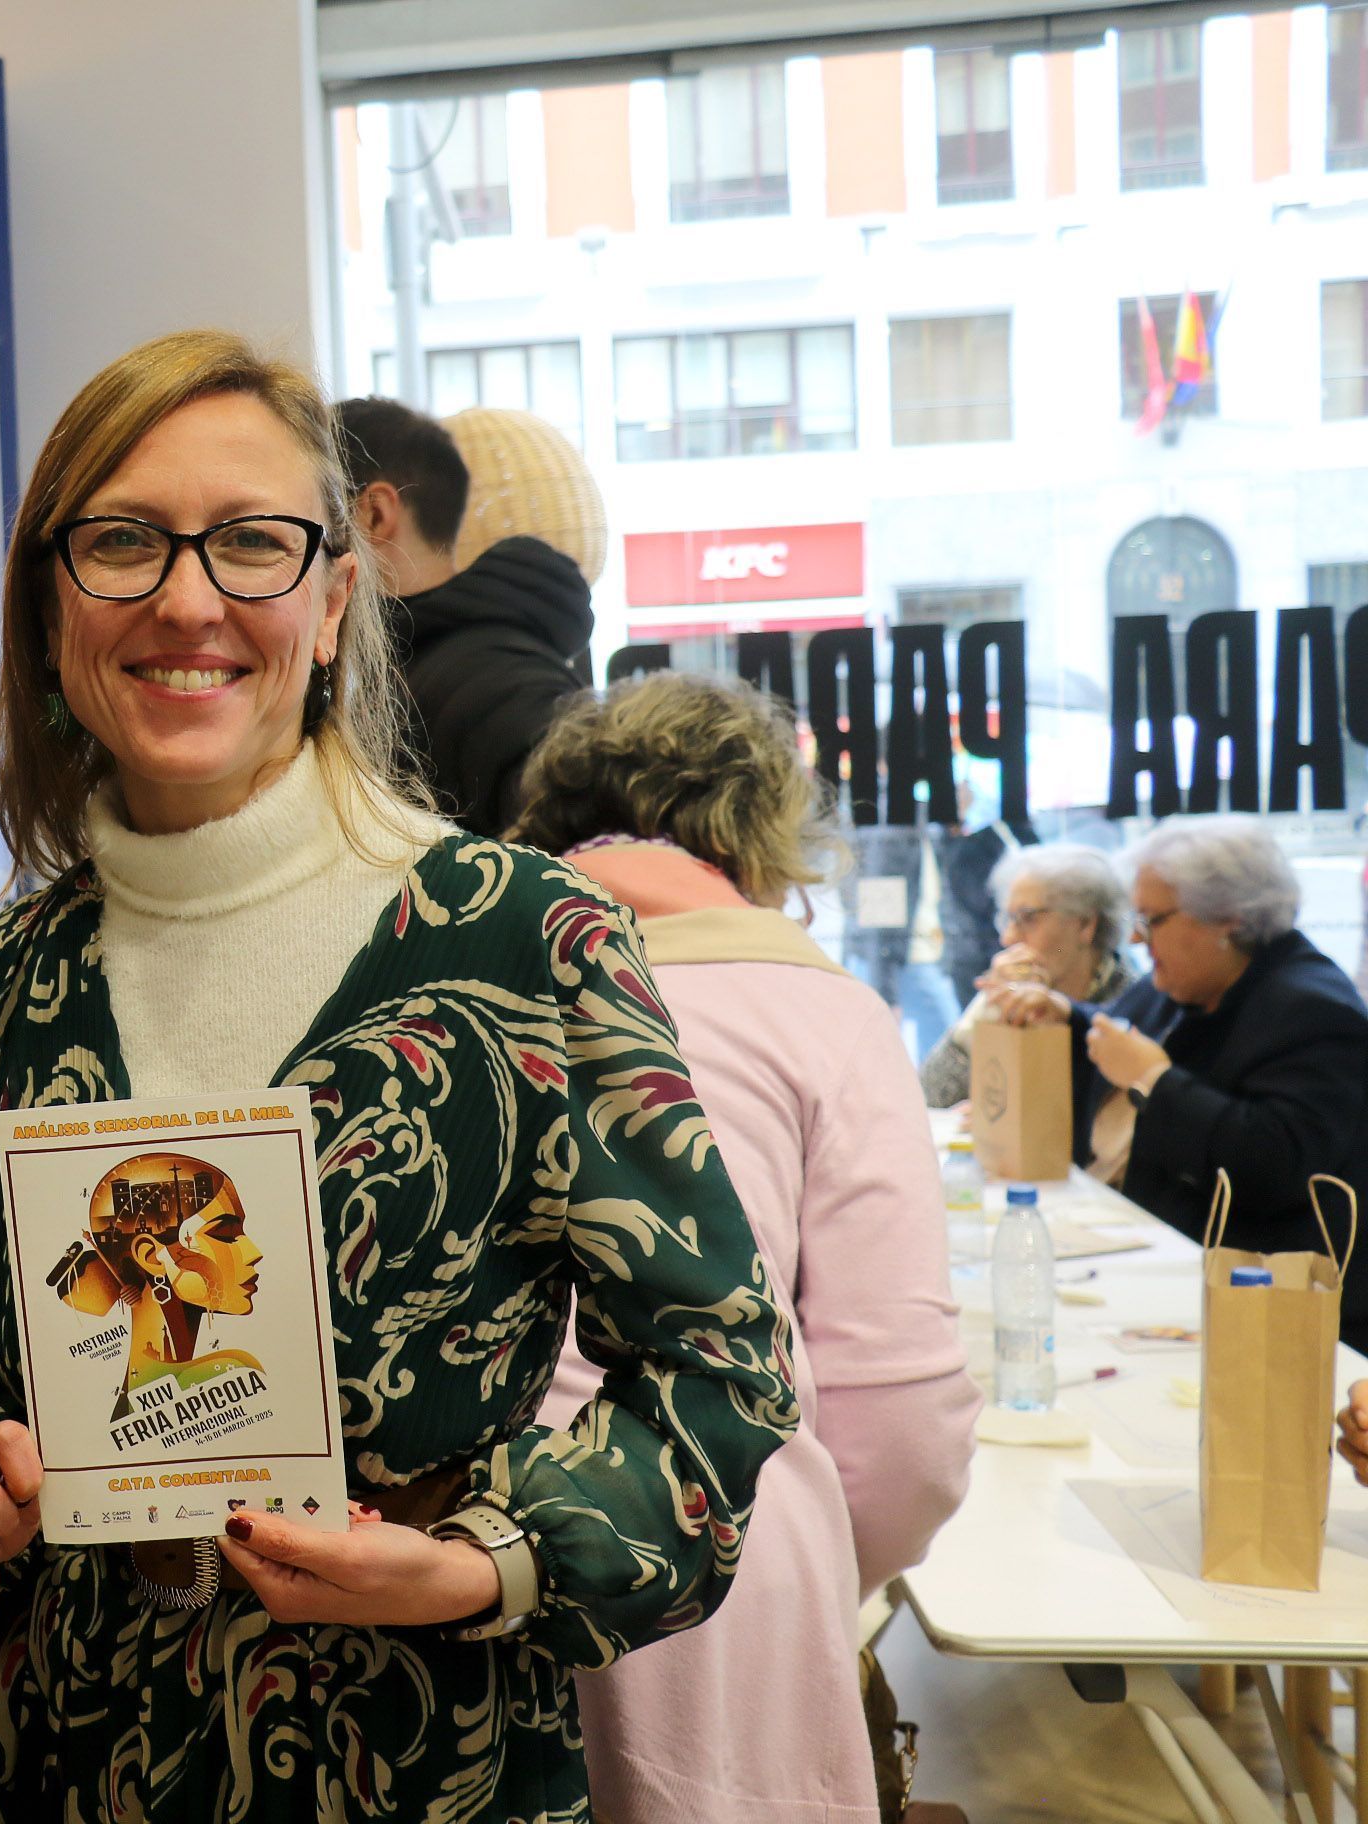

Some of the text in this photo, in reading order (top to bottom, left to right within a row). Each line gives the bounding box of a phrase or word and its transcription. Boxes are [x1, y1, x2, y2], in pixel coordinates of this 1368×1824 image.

[699, 542, 788, 580] KFC
[13, 1105, 294, 1140] ANÁLISIS SENSORIAL DE LA MIEL
[68, 1324, 129, 1358] PASTRANA
[109, 1370, 267, 1452] FERIA APÍCOLA
[135, 1382, 175, 1412] XLIV
[160, 1405, 248, 1449] INTERNACIONAL
[214, 1430, 223, 1441] DE
[223, 1420, 246, 1437] MARZO
[246, 1416, 255, 1427] DE
[255, 1409, 274, 1424] 2025
[107, 1468, 272, 1492] CATA COMENTADA
